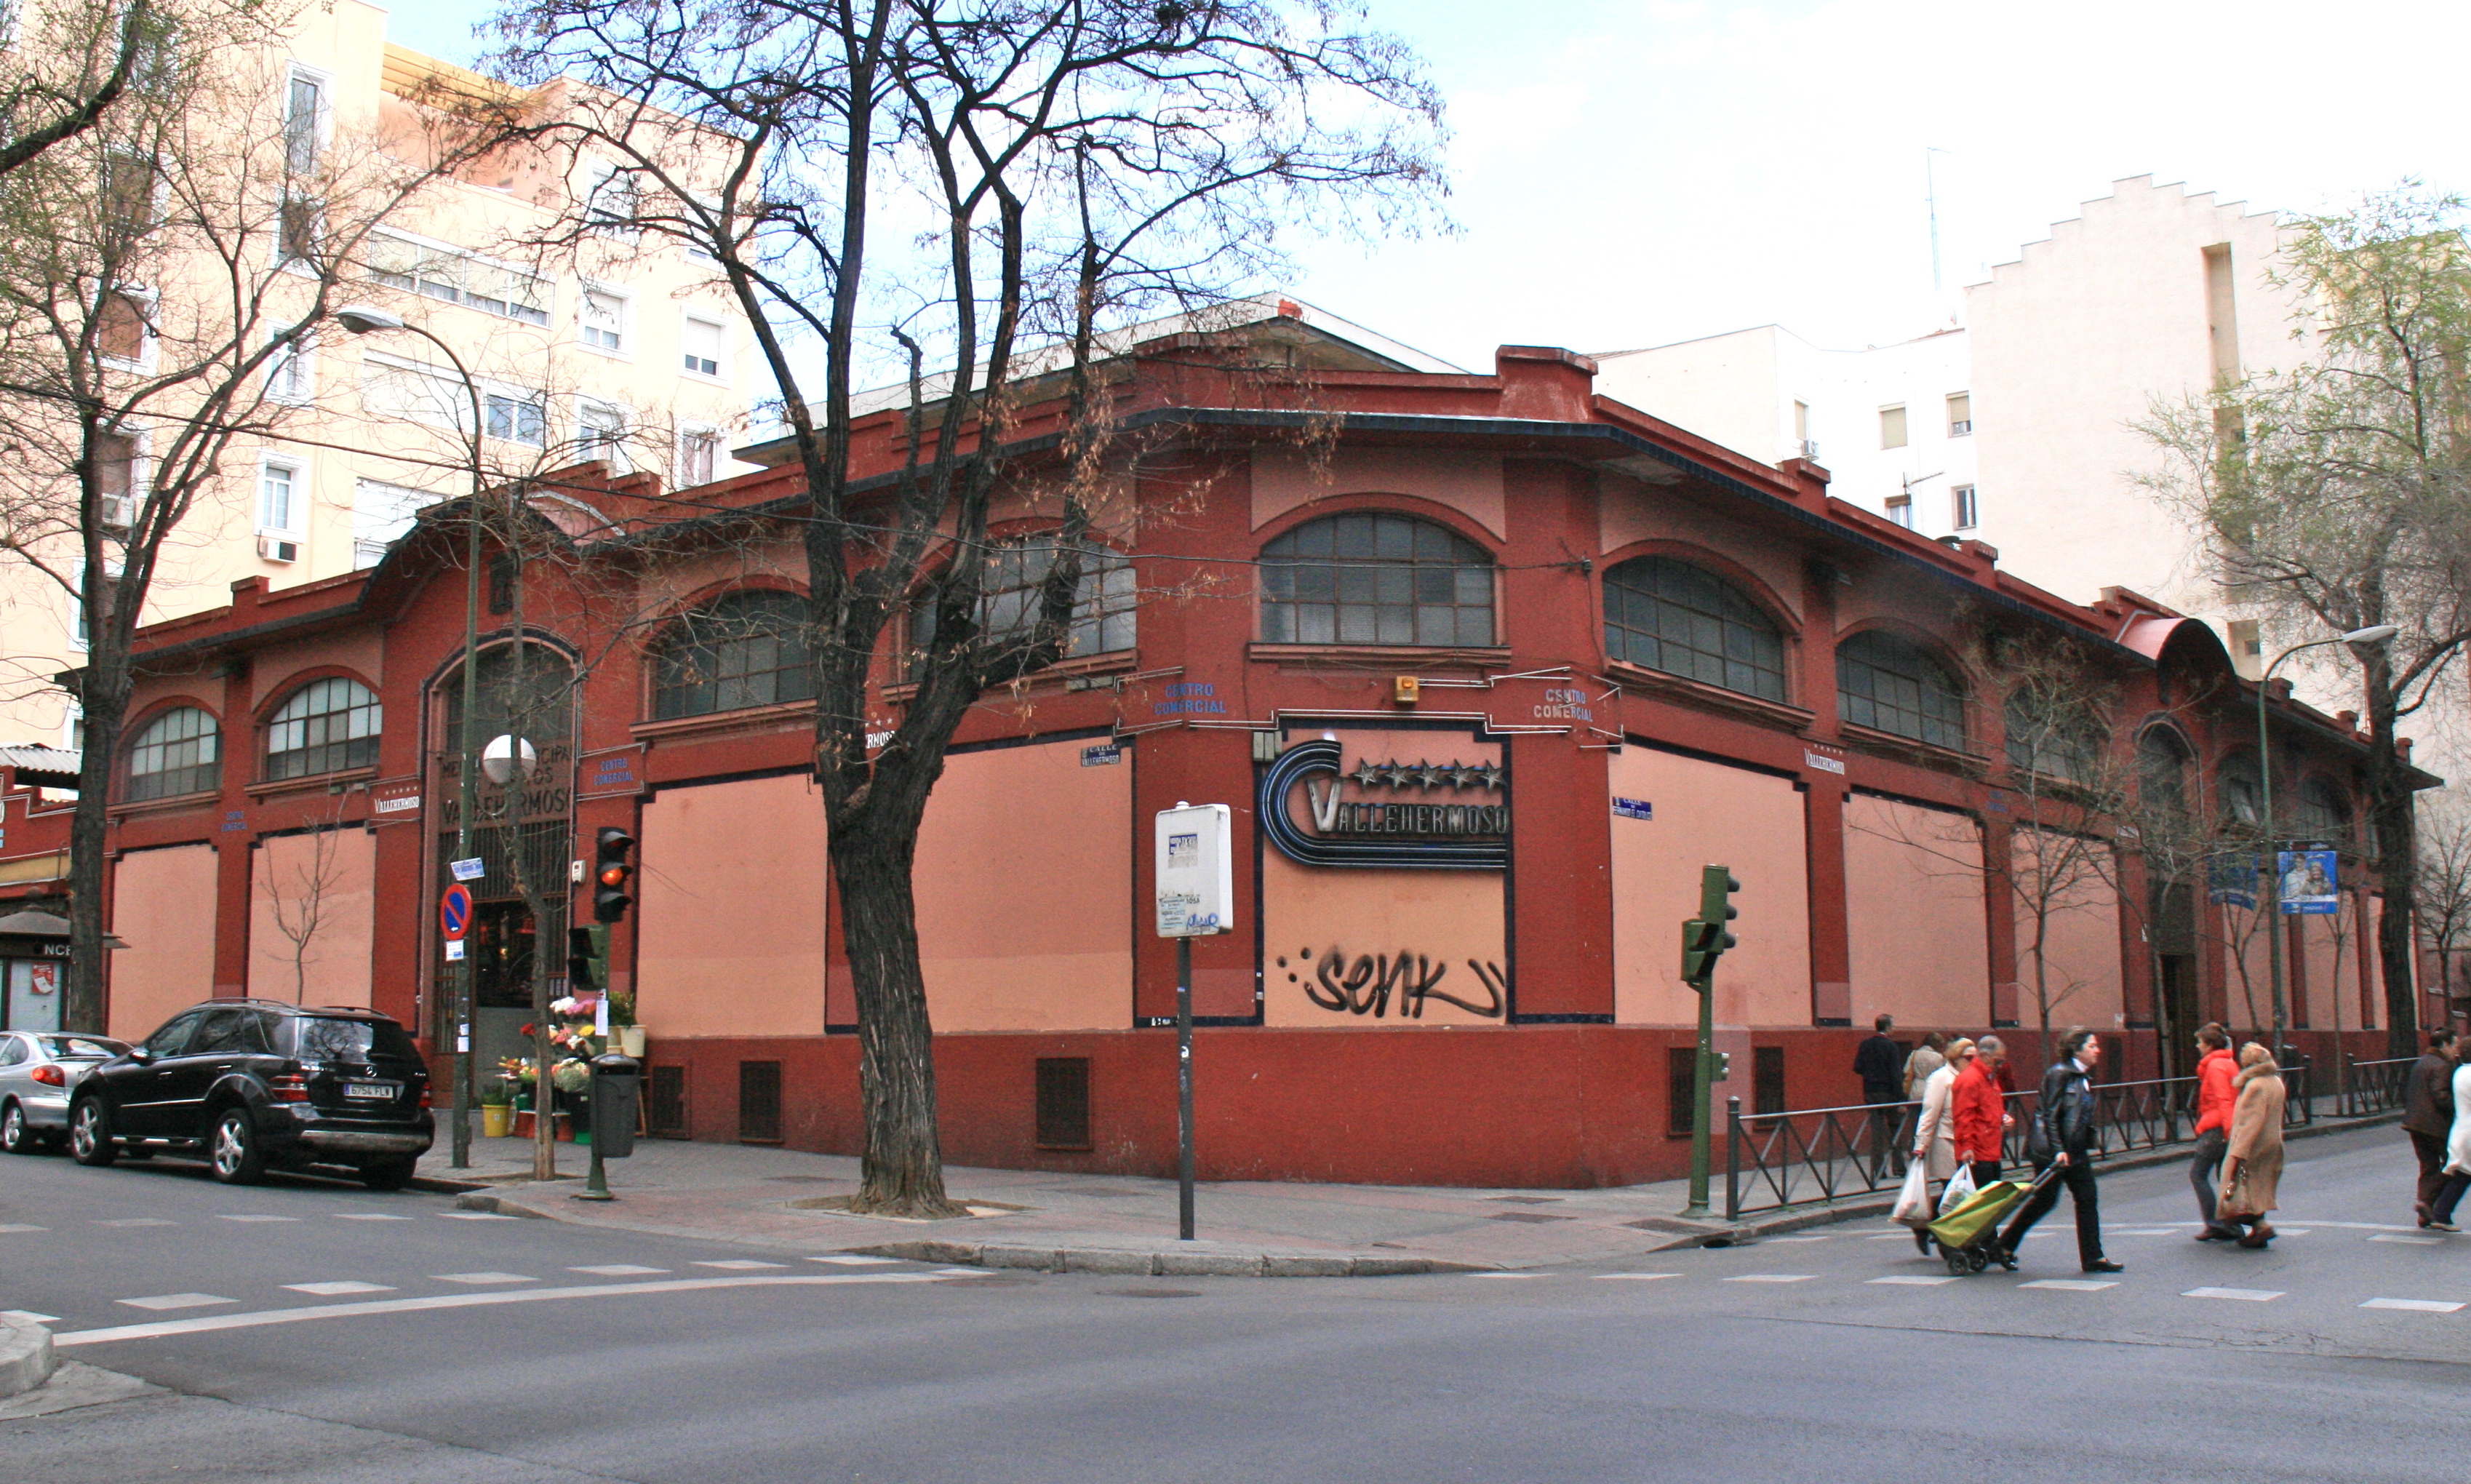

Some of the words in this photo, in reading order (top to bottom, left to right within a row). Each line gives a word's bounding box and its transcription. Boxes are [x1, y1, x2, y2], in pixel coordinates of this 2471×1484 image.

[1165, 682, 1214, 698] CENTRO
[1545, 688, 1586, 704] CENTRO
[1154, 699, 1227, 714] COMERCIAL
[1533, 705, 1594, 722] COMERCIAL
[1089, 743, 1118, 753] CALLE
[1307, 777, 1510, 835] VALLEHERMOSO
